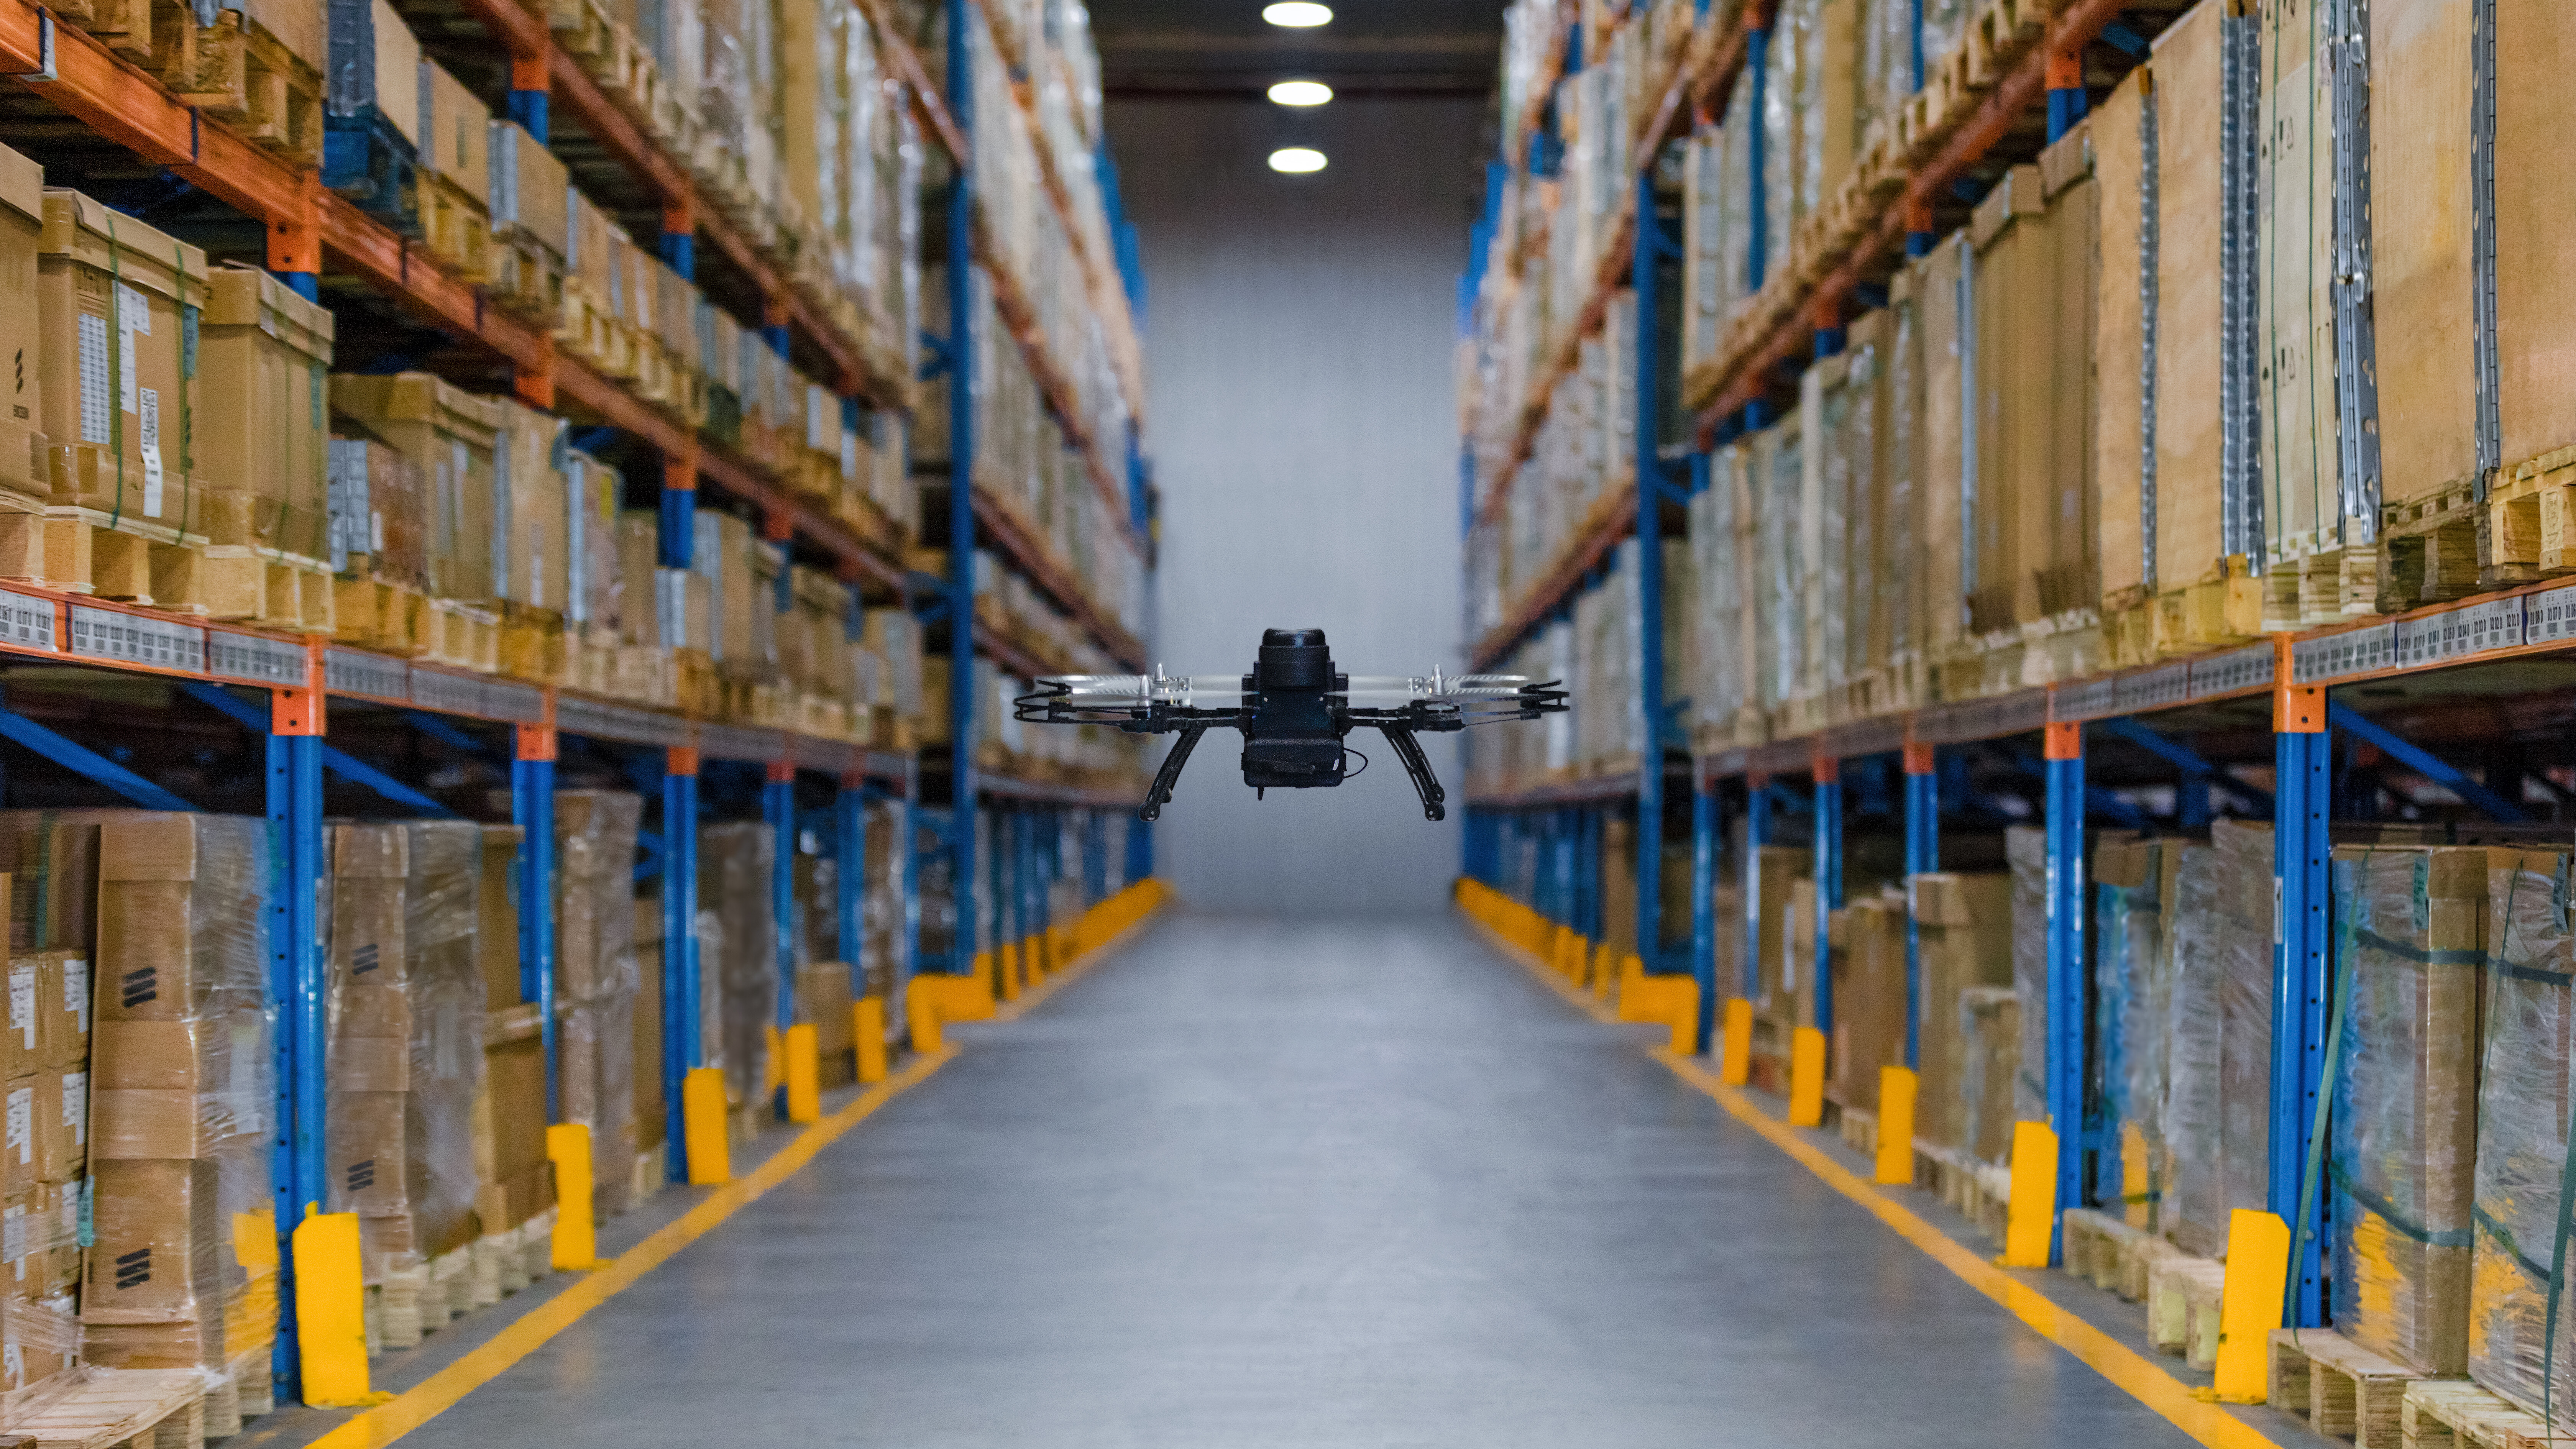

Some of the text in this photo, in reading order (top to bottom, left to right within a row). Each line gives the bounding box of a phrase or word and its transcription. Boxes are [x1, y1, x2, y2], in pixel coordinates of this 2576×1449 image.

[2530, 612, 2534, 625] 01
[2548, 607, 2552, 621] 01
[2553, 607, 2557, 620] 07
[2566, 605, 2570, 619] 01
[2507, 614, 2511, 627] 02
[2512, 614, 2516, 627] 01
